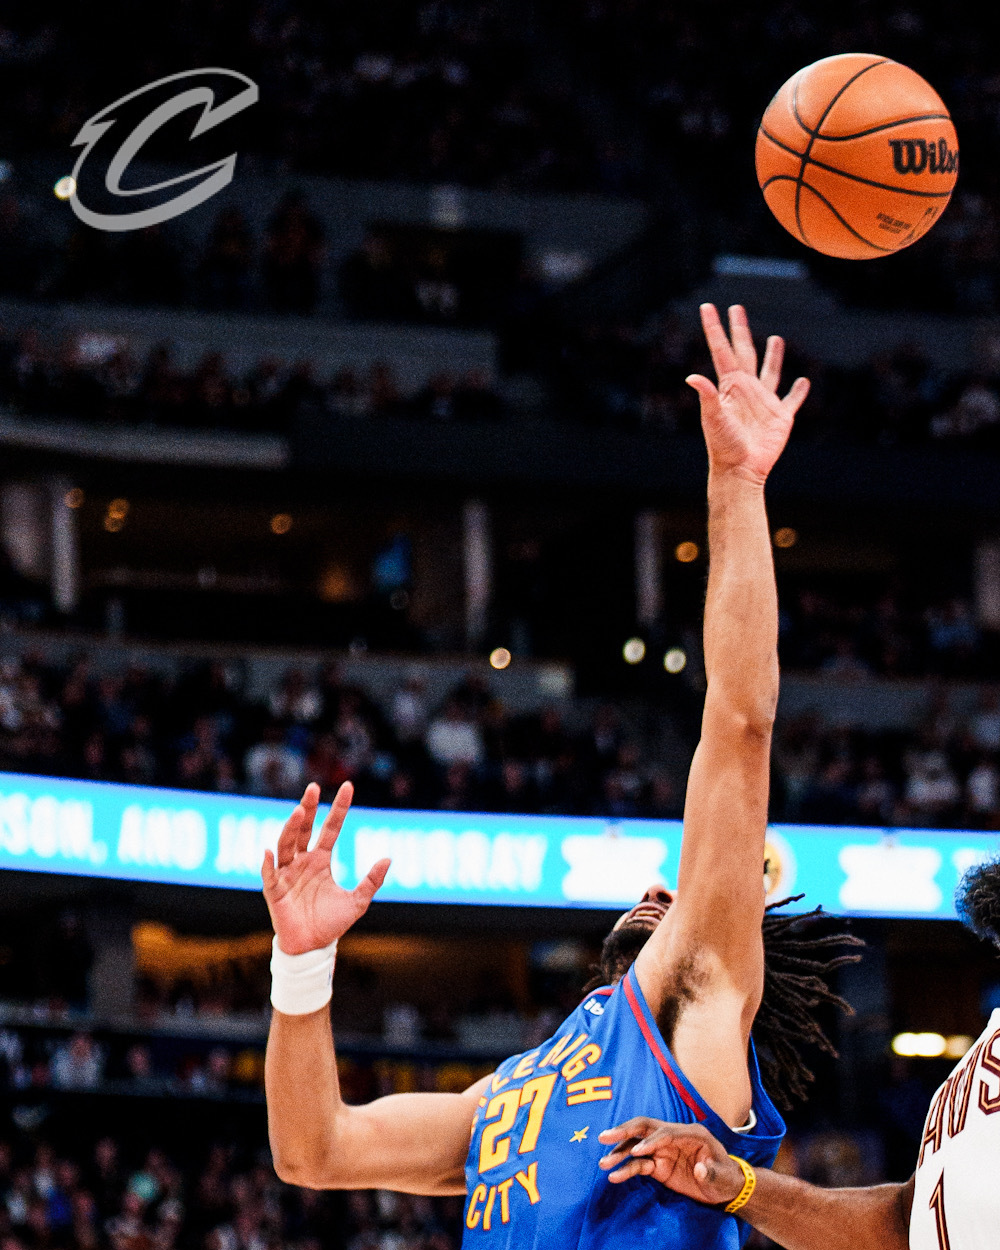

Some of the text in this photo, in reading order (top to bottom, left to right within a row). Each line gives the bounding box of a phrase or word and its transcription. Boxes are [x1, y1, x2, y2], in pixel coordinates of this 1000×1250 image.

[0, 793, 107, 864] SON,
[478, 1071, 559, 1175] 27
[466, 1160, 541, 1231] CITY
